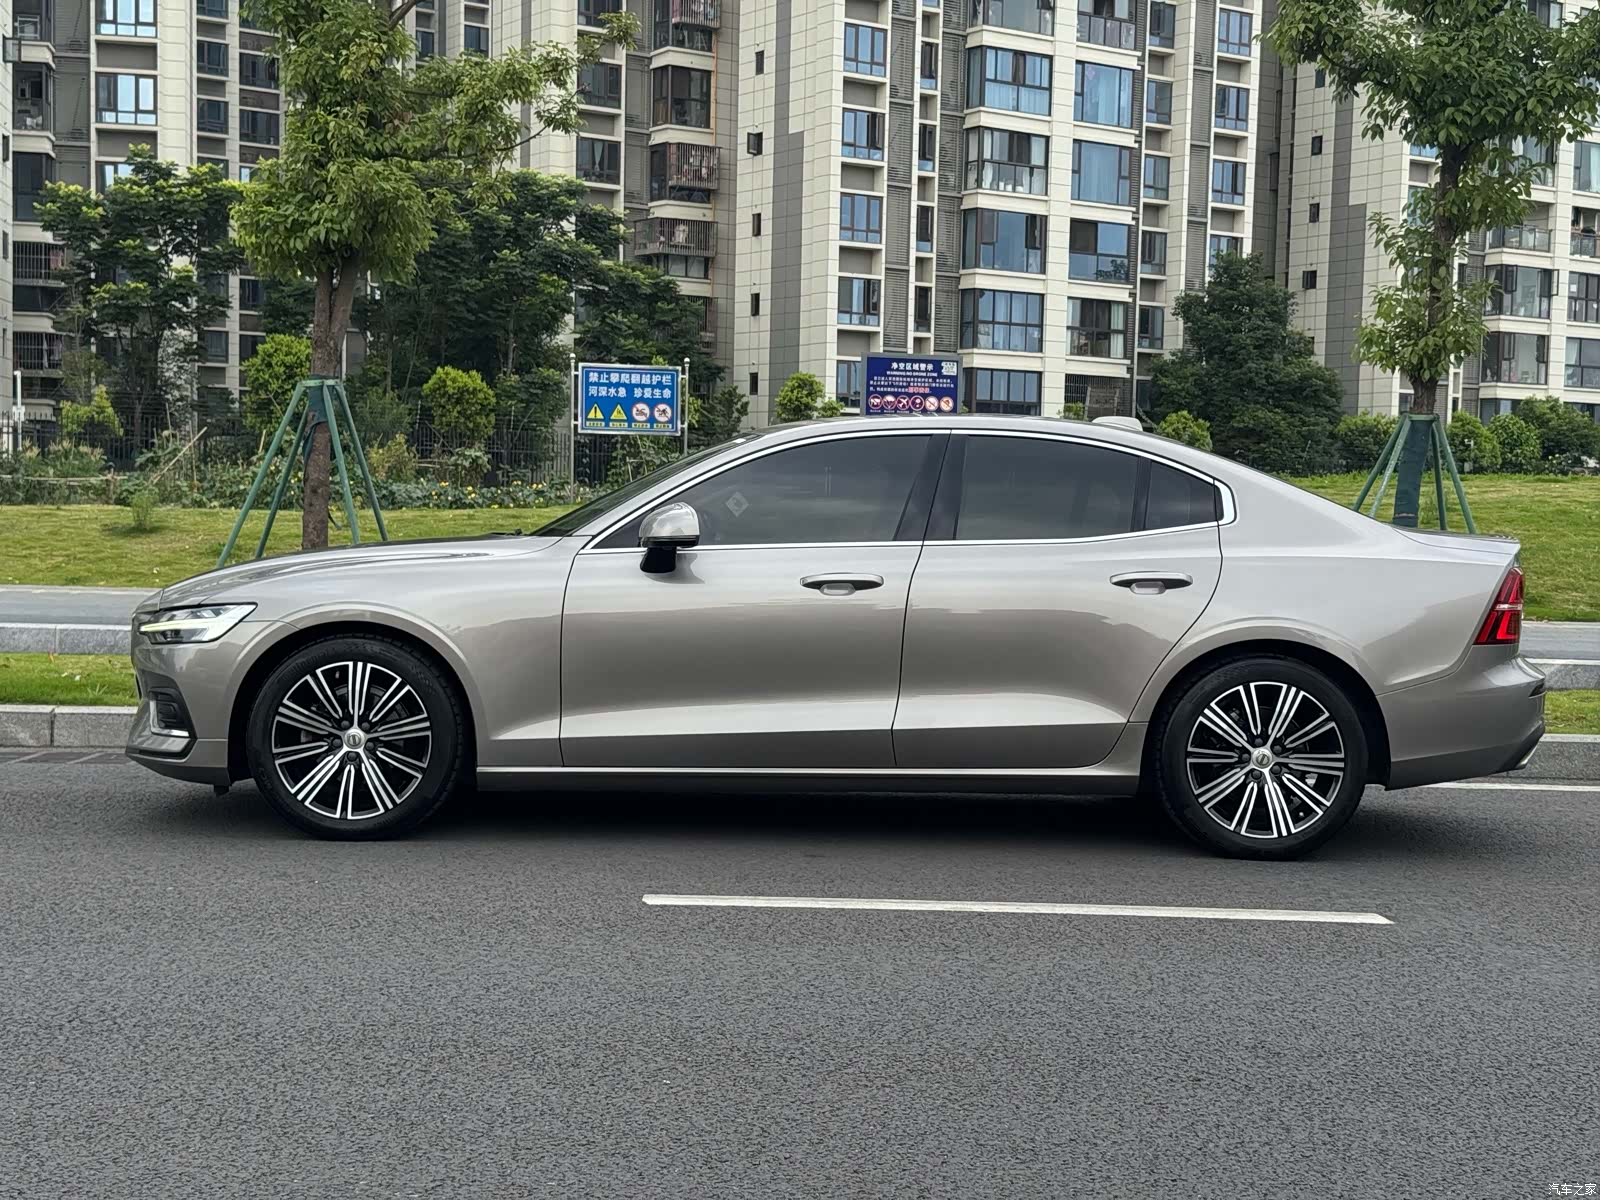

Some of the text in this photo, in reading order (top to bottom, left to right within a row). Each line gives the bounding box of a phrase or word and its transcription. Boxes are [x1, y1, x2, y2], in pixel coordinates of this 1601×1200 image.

[891, 362, 934, 371] 净空区域警示
[588, 372, 672, 385] 禁止攀爬翻越护栏
[588, 386, 672, 399] 河深水急 珍爱生命
